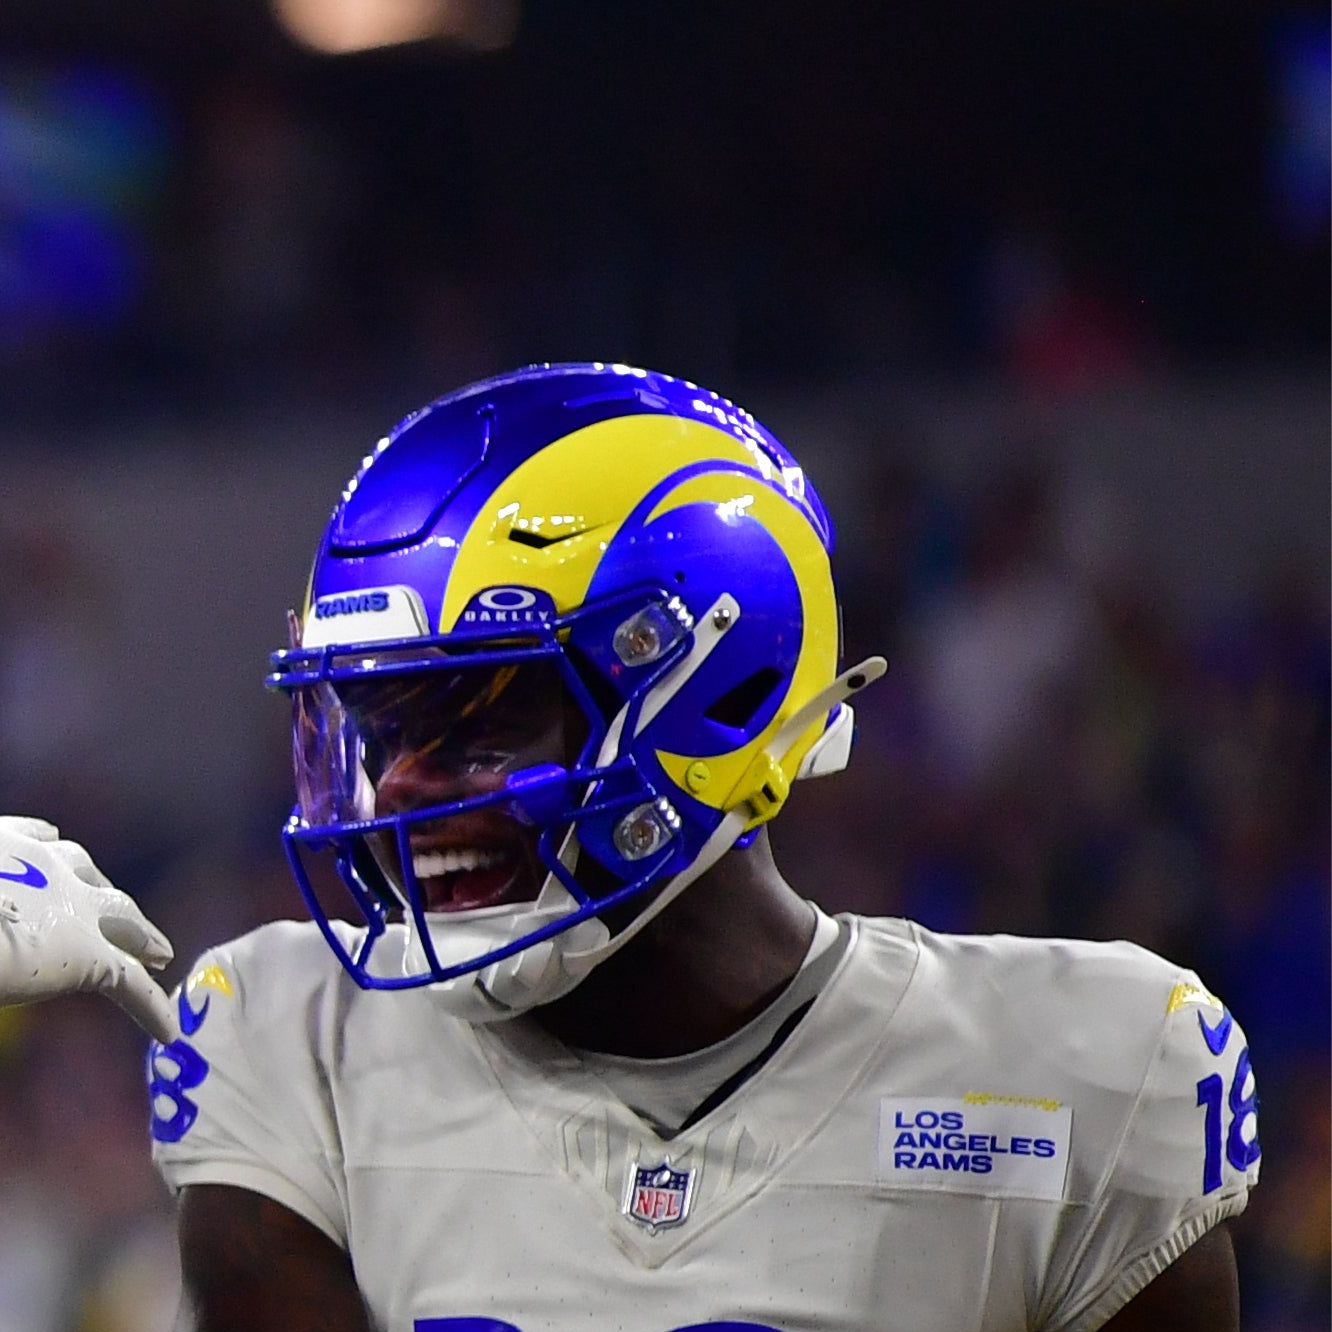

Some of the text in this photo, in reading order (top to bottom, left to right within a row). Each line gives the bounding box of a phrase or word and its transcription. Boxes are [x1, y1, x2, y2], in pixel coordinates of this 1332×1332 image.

[464, 610, 550, 622] OAKLEY
[894, 1110, 964, 1131] LOS
[1196, 1046, 1262, 1197] 18
[893, 1132, 1056, 1158] ANGELES
[894, 1152, 993, 1174] RAMS
[636, 1189, 679, 1219] NFL
